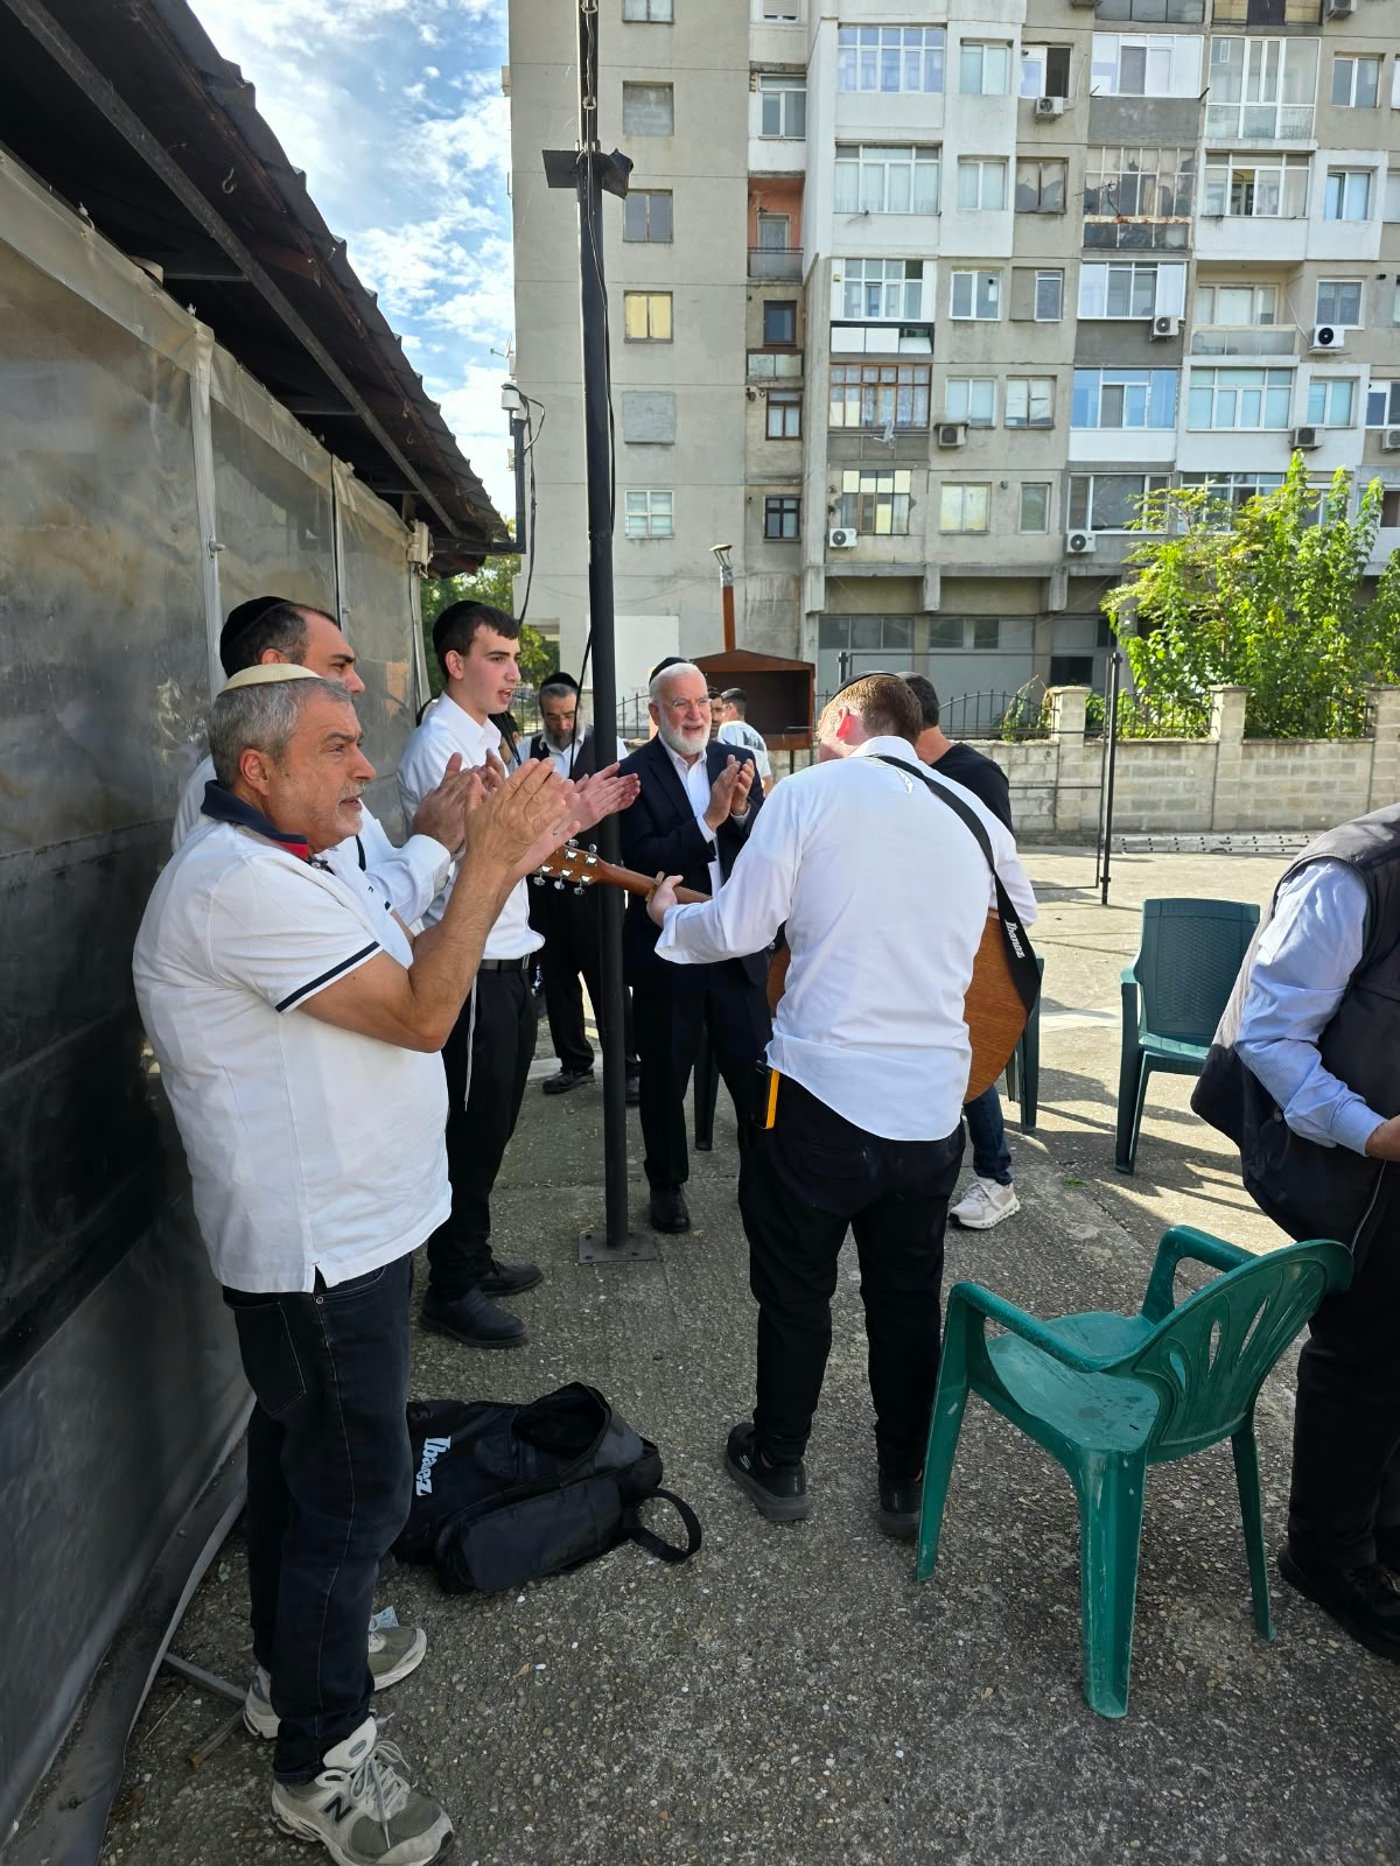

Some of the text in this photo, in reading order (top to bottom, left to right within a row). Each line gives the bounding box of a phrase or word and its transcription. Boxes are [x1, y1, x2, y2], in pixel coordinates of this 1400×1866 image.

[1004, 919, 1025, 959] Ibanez
[416, 1435, 451, 1496] Ibaez
[321, 1794, 354, 1824] N
